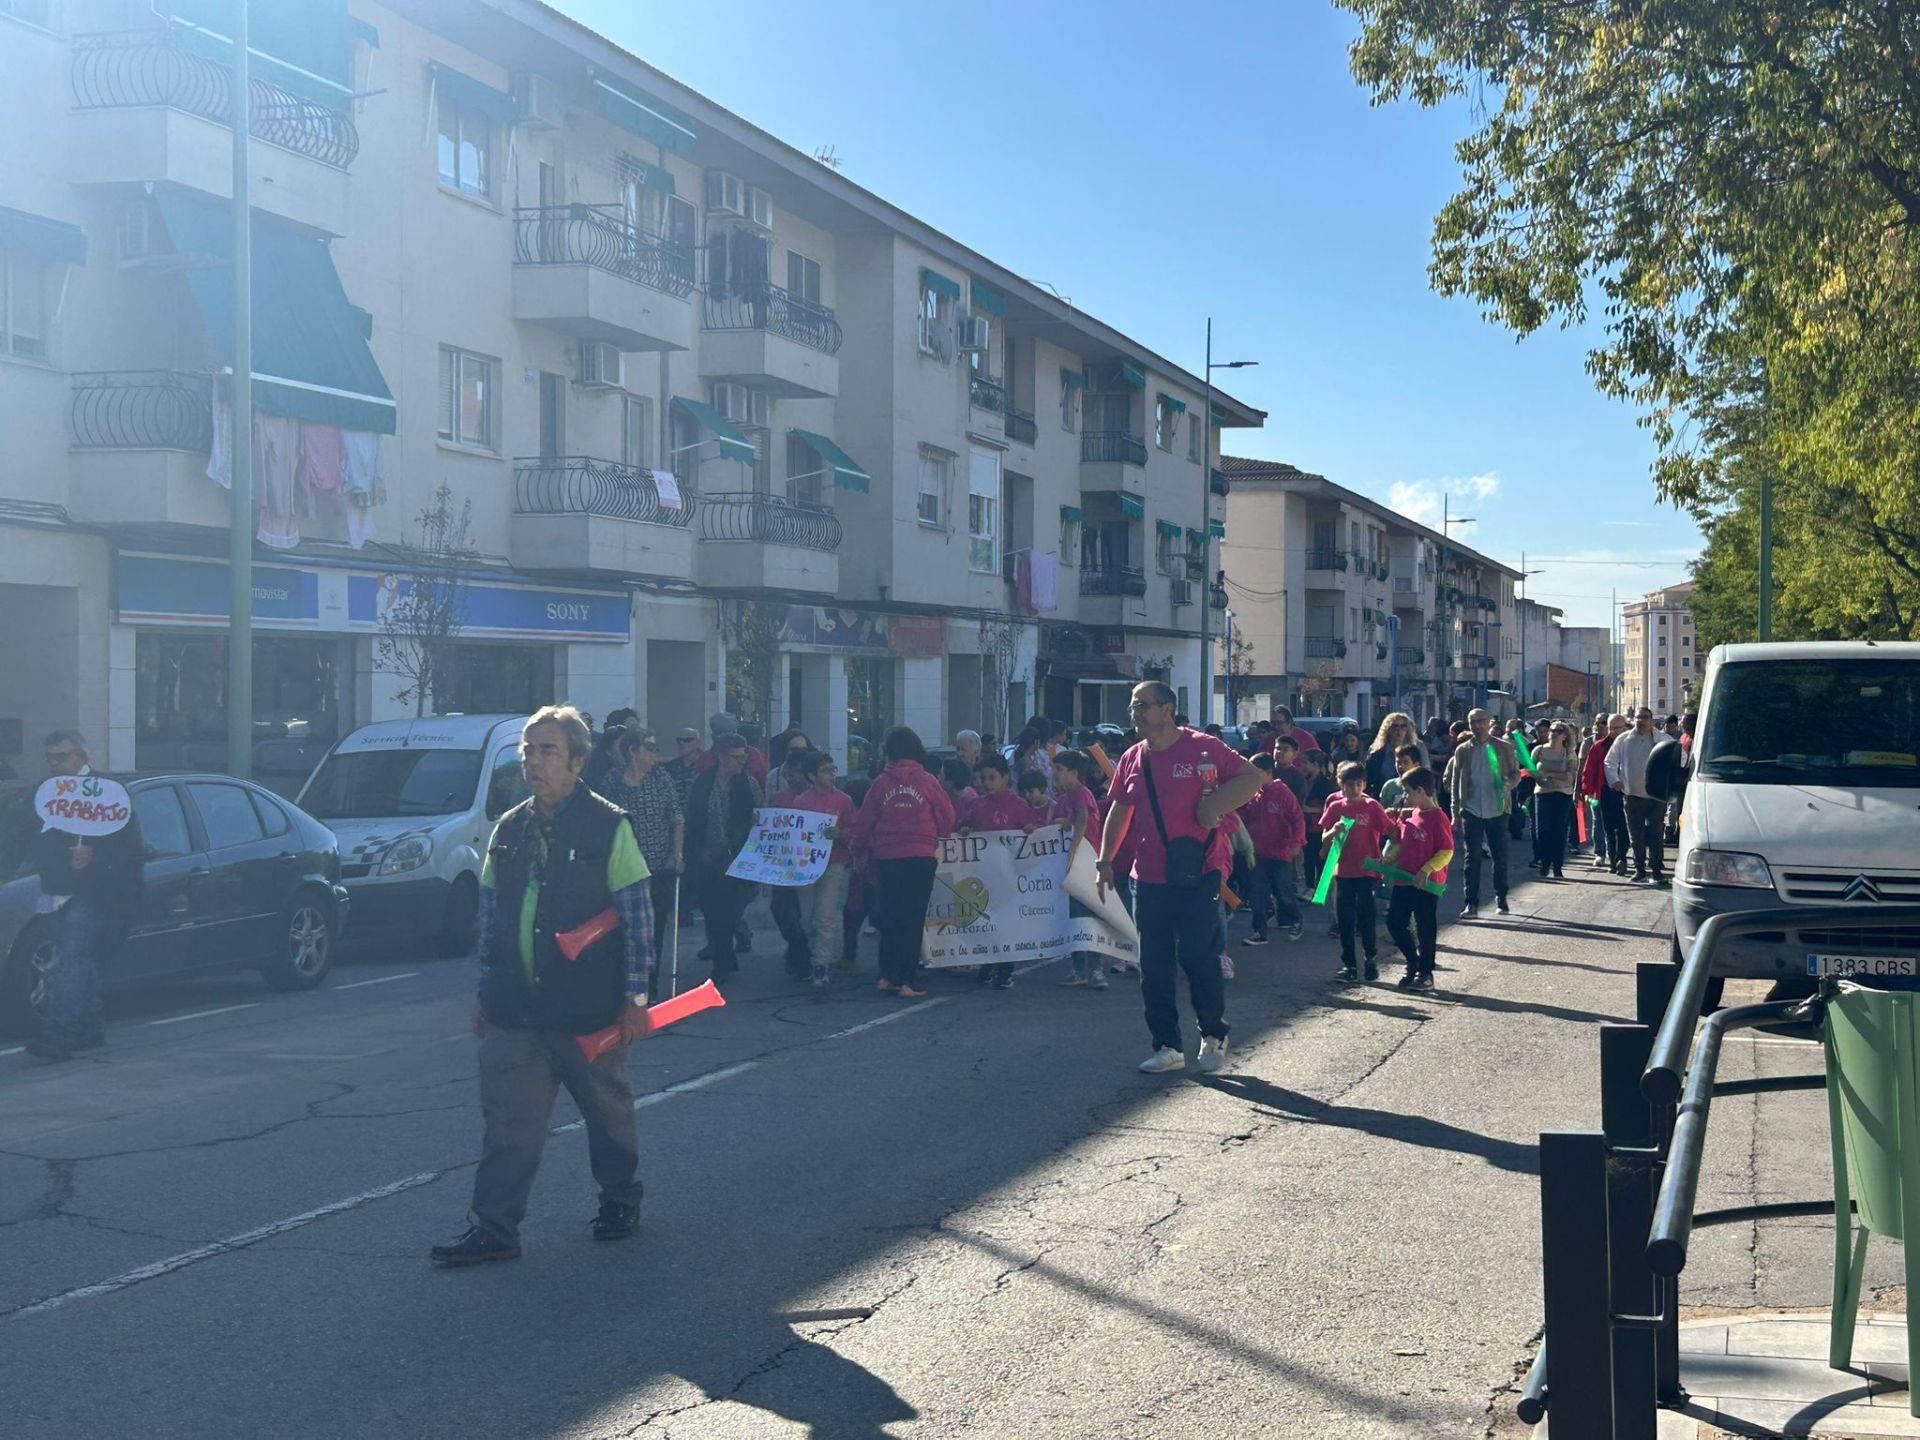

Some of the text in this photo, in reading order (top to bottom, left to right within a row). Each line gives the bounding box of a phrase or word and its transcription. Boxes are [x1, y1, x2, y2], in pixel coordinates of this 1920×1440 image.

[546, 602, 591, 620] SONY
[44, 799, 129, 822] TRABAJO
[801, 831, 815, 843] DE
[939, 836, 988, 864] EIP
[1017, 874, 1053, 894] Coria
[1822, 958, 1868, 975] 1383
